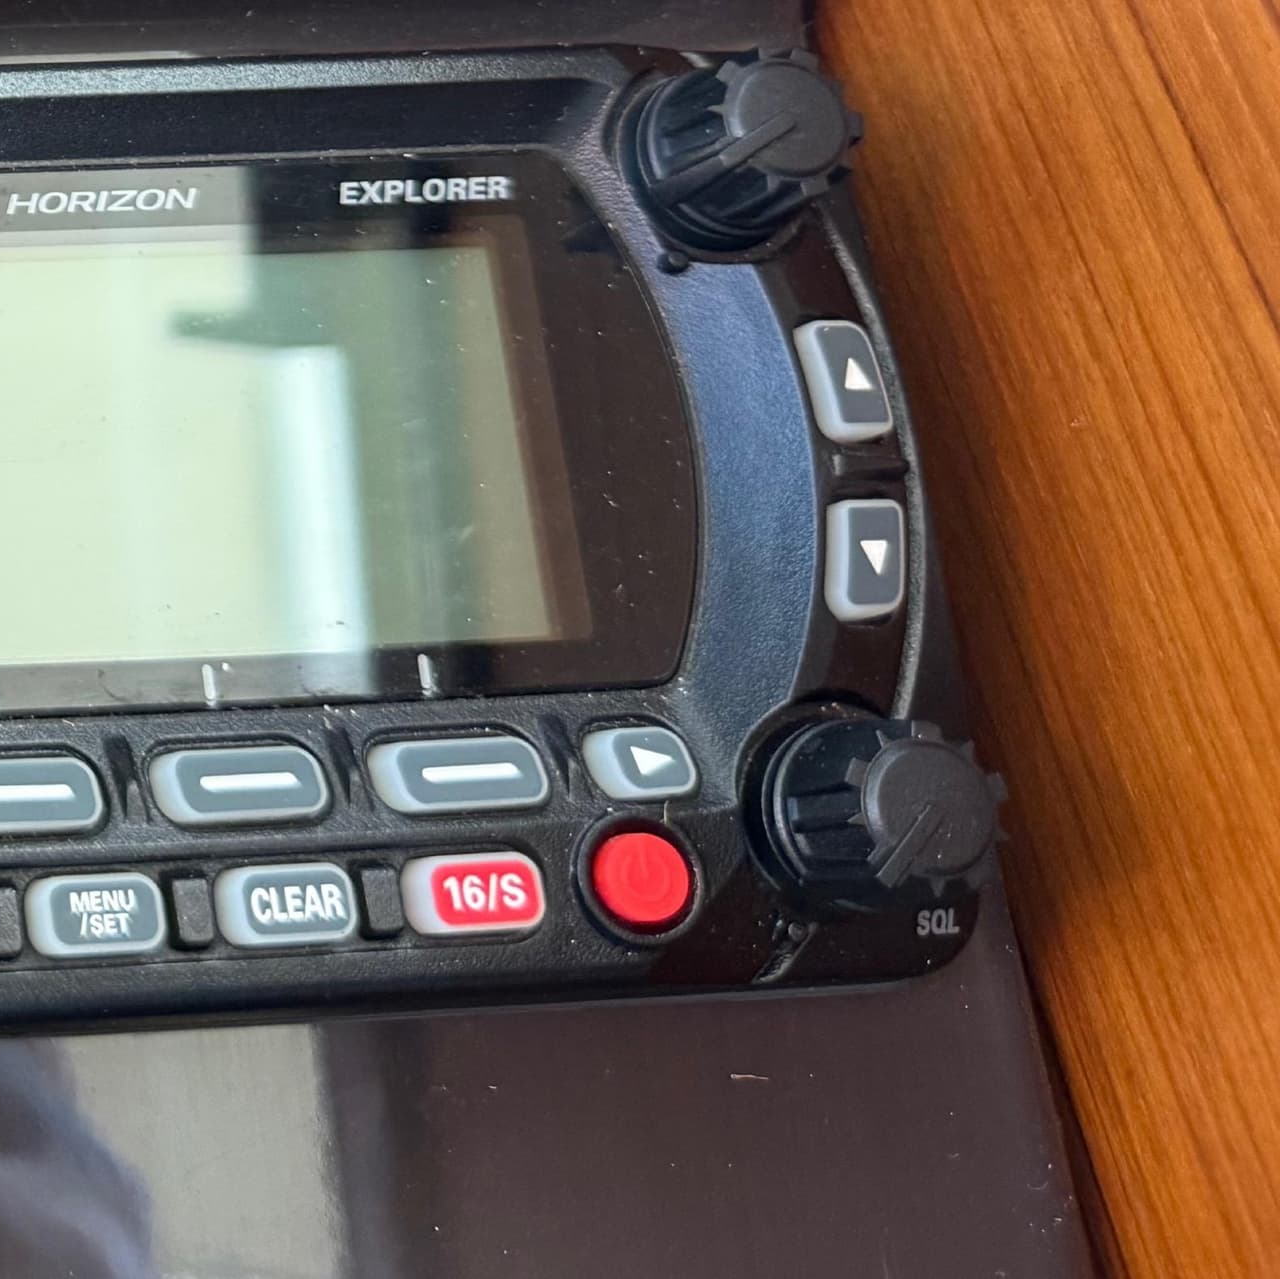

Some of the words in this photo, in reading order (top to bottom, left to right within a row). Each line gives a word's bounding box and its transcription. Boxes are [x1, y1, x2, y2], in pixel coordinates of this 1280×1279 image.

[6, 186, 197, 216] HORIZON
[339, 175, 512, 207] EXPLORER
[69, 889, 135, 914] MENU
[250, 884, 344, 922] CLEAR
[442, 872, 527, 912] 16/S
[79, 912, 131, 937] /SET
[917, 910, 959, 936] SQL
